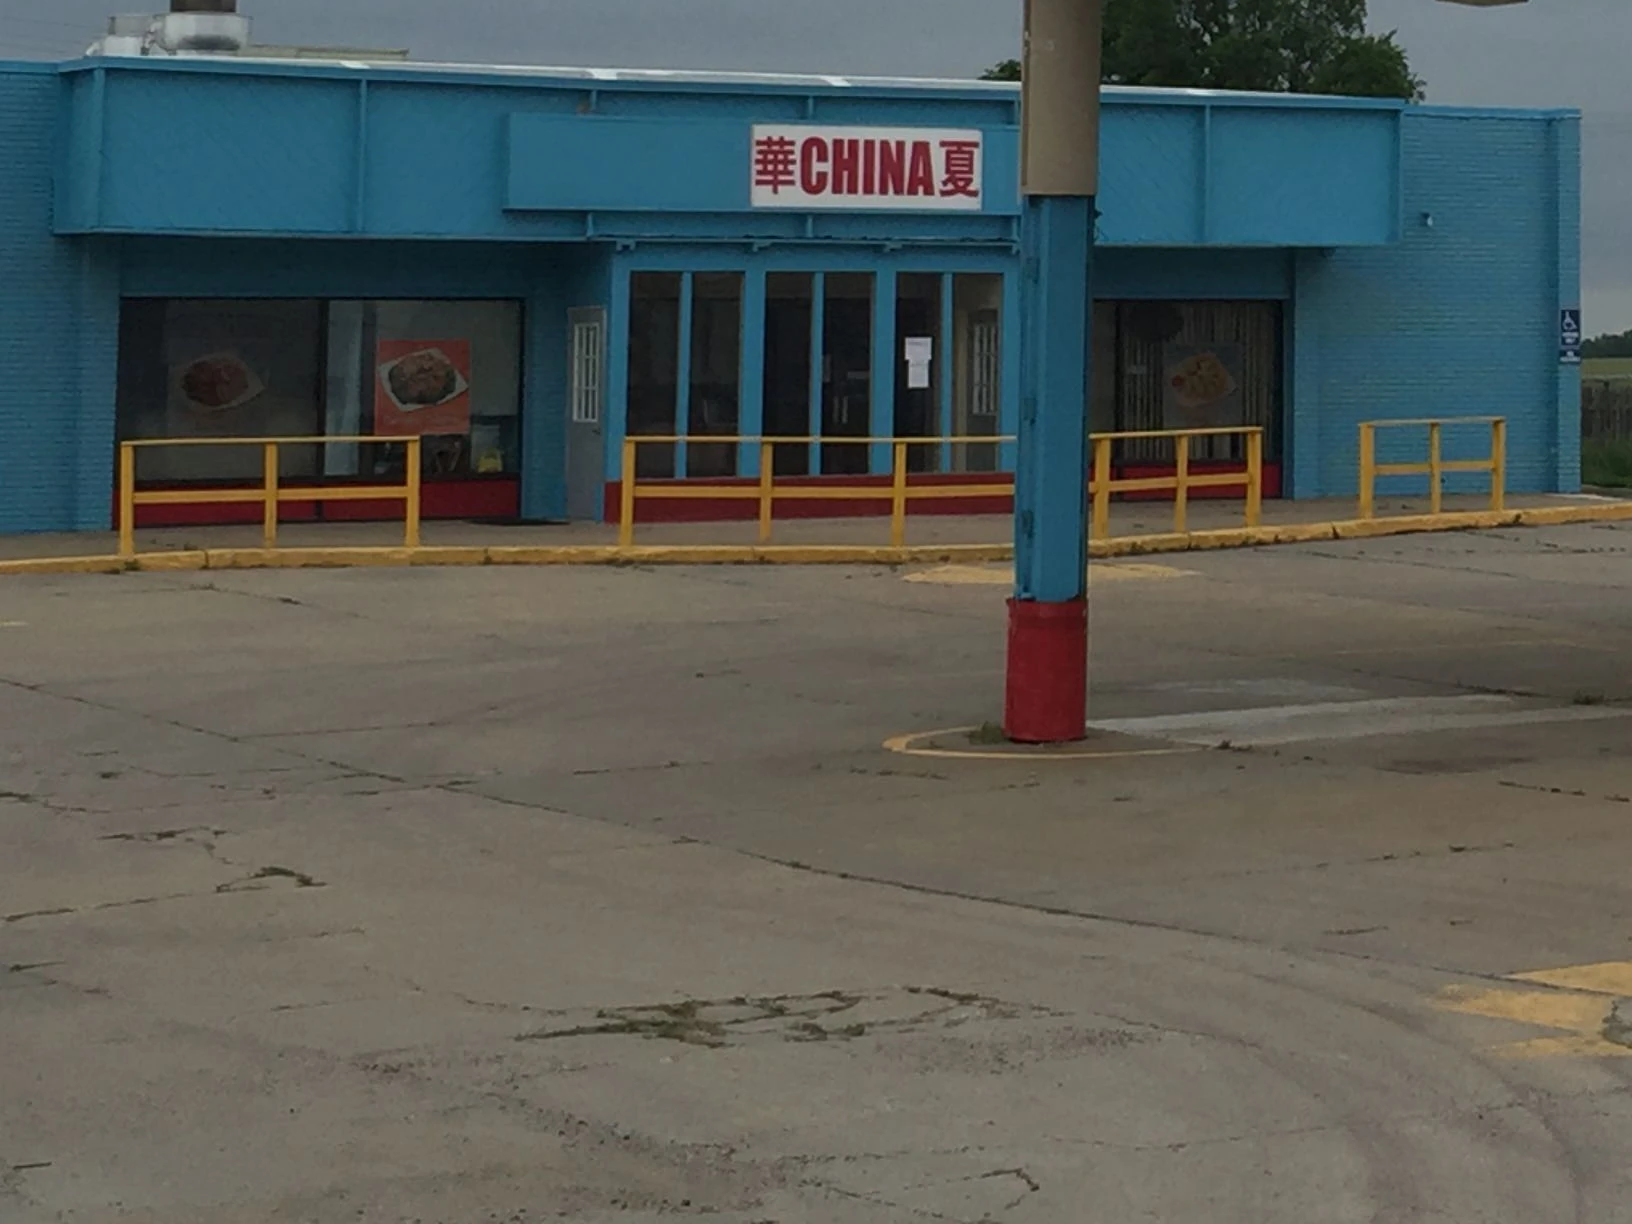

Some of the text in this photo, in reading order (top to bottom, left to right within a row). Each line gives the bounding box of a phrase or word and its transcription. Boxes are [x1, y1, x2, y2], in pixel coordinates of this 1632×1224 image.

[754, 136, 980, 198] 華 CHINA 夏
